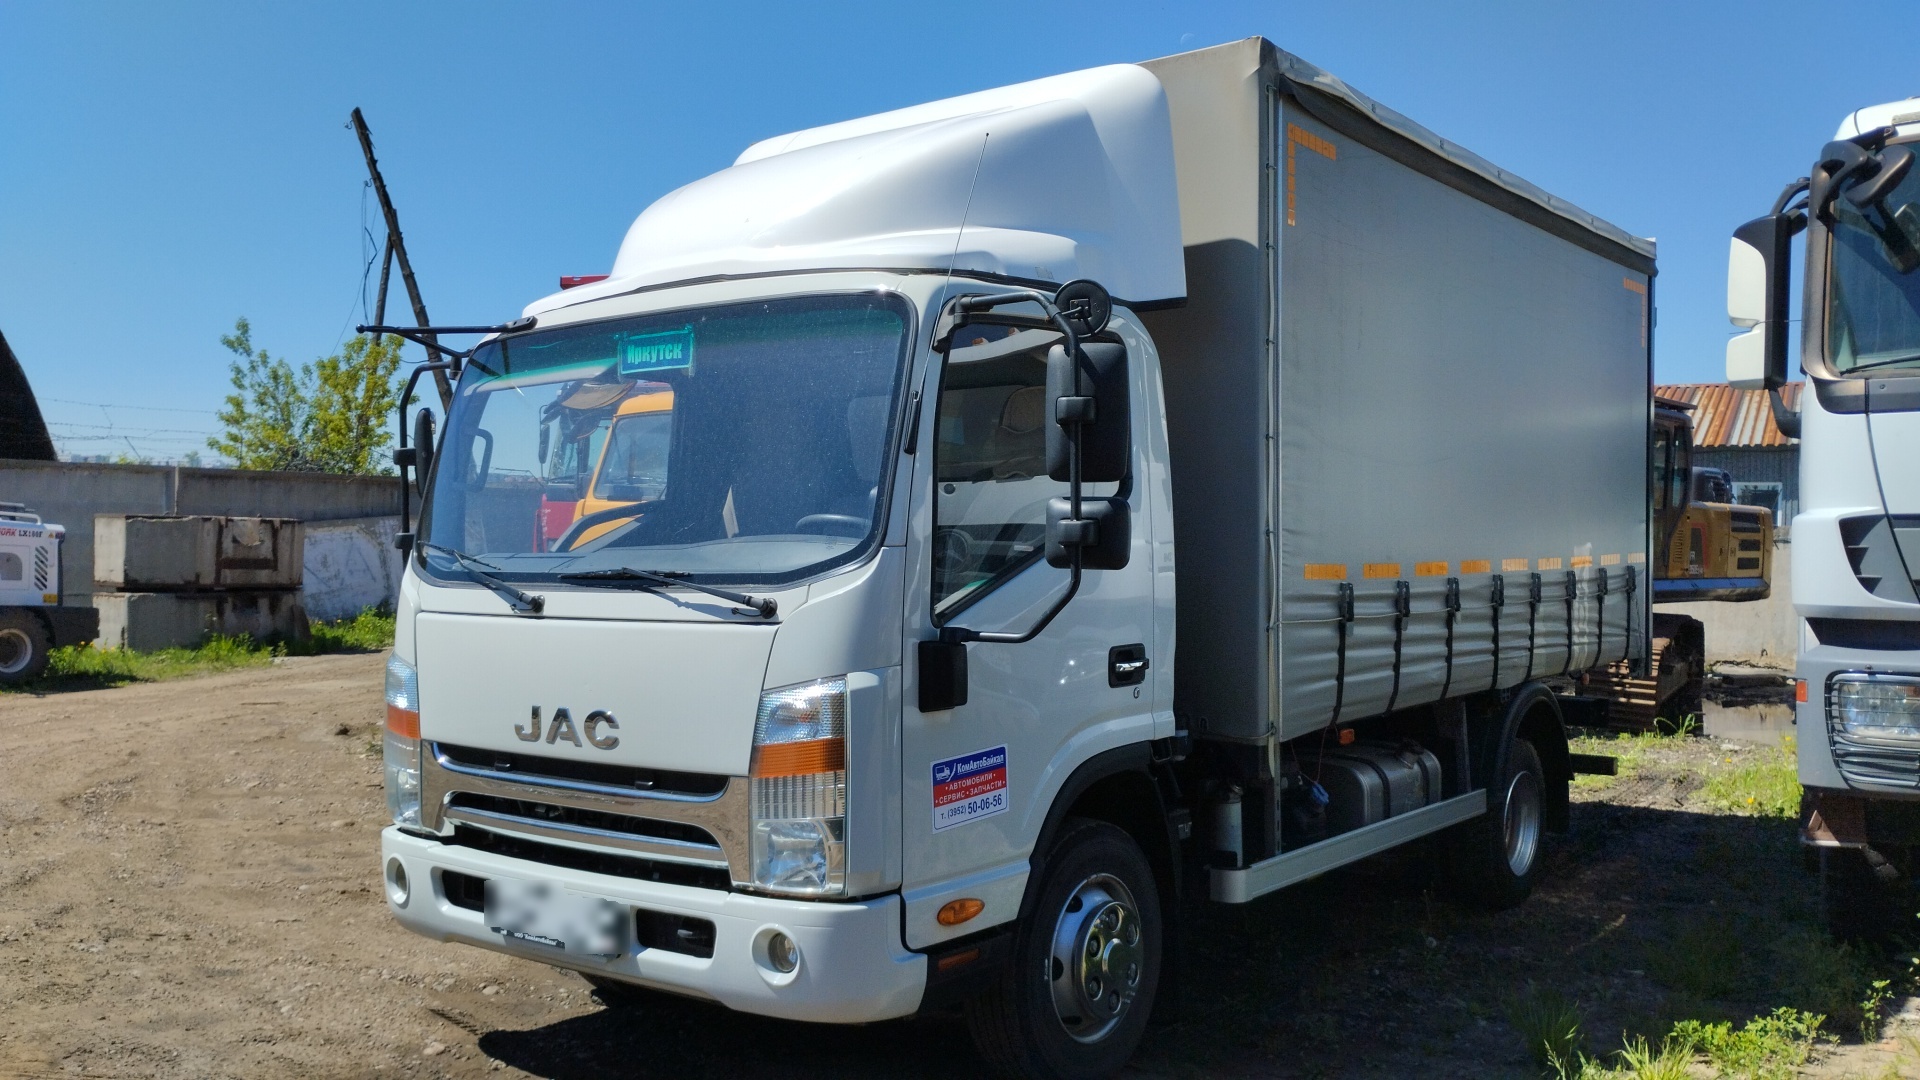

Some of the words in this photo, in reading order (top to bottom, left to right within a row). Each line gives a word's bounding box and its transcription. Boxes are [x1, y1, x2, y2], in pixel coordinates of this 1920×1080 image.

[627, 343, 683, 365] Иркутск
[514, 705, 620, 750] JAC
[957, 754, 1004, 775] КомАвтоБайкал
[939, 791, 966, 804] СЕРВИС
[970, 780, 1002, 796] ЗАПЧАСТИ
[949, 772, 993, 791] АВТОМОБИЛИ
[948, 804, 967, 819] (3952)
[968, 794, 1002, 814] 50-06-56
